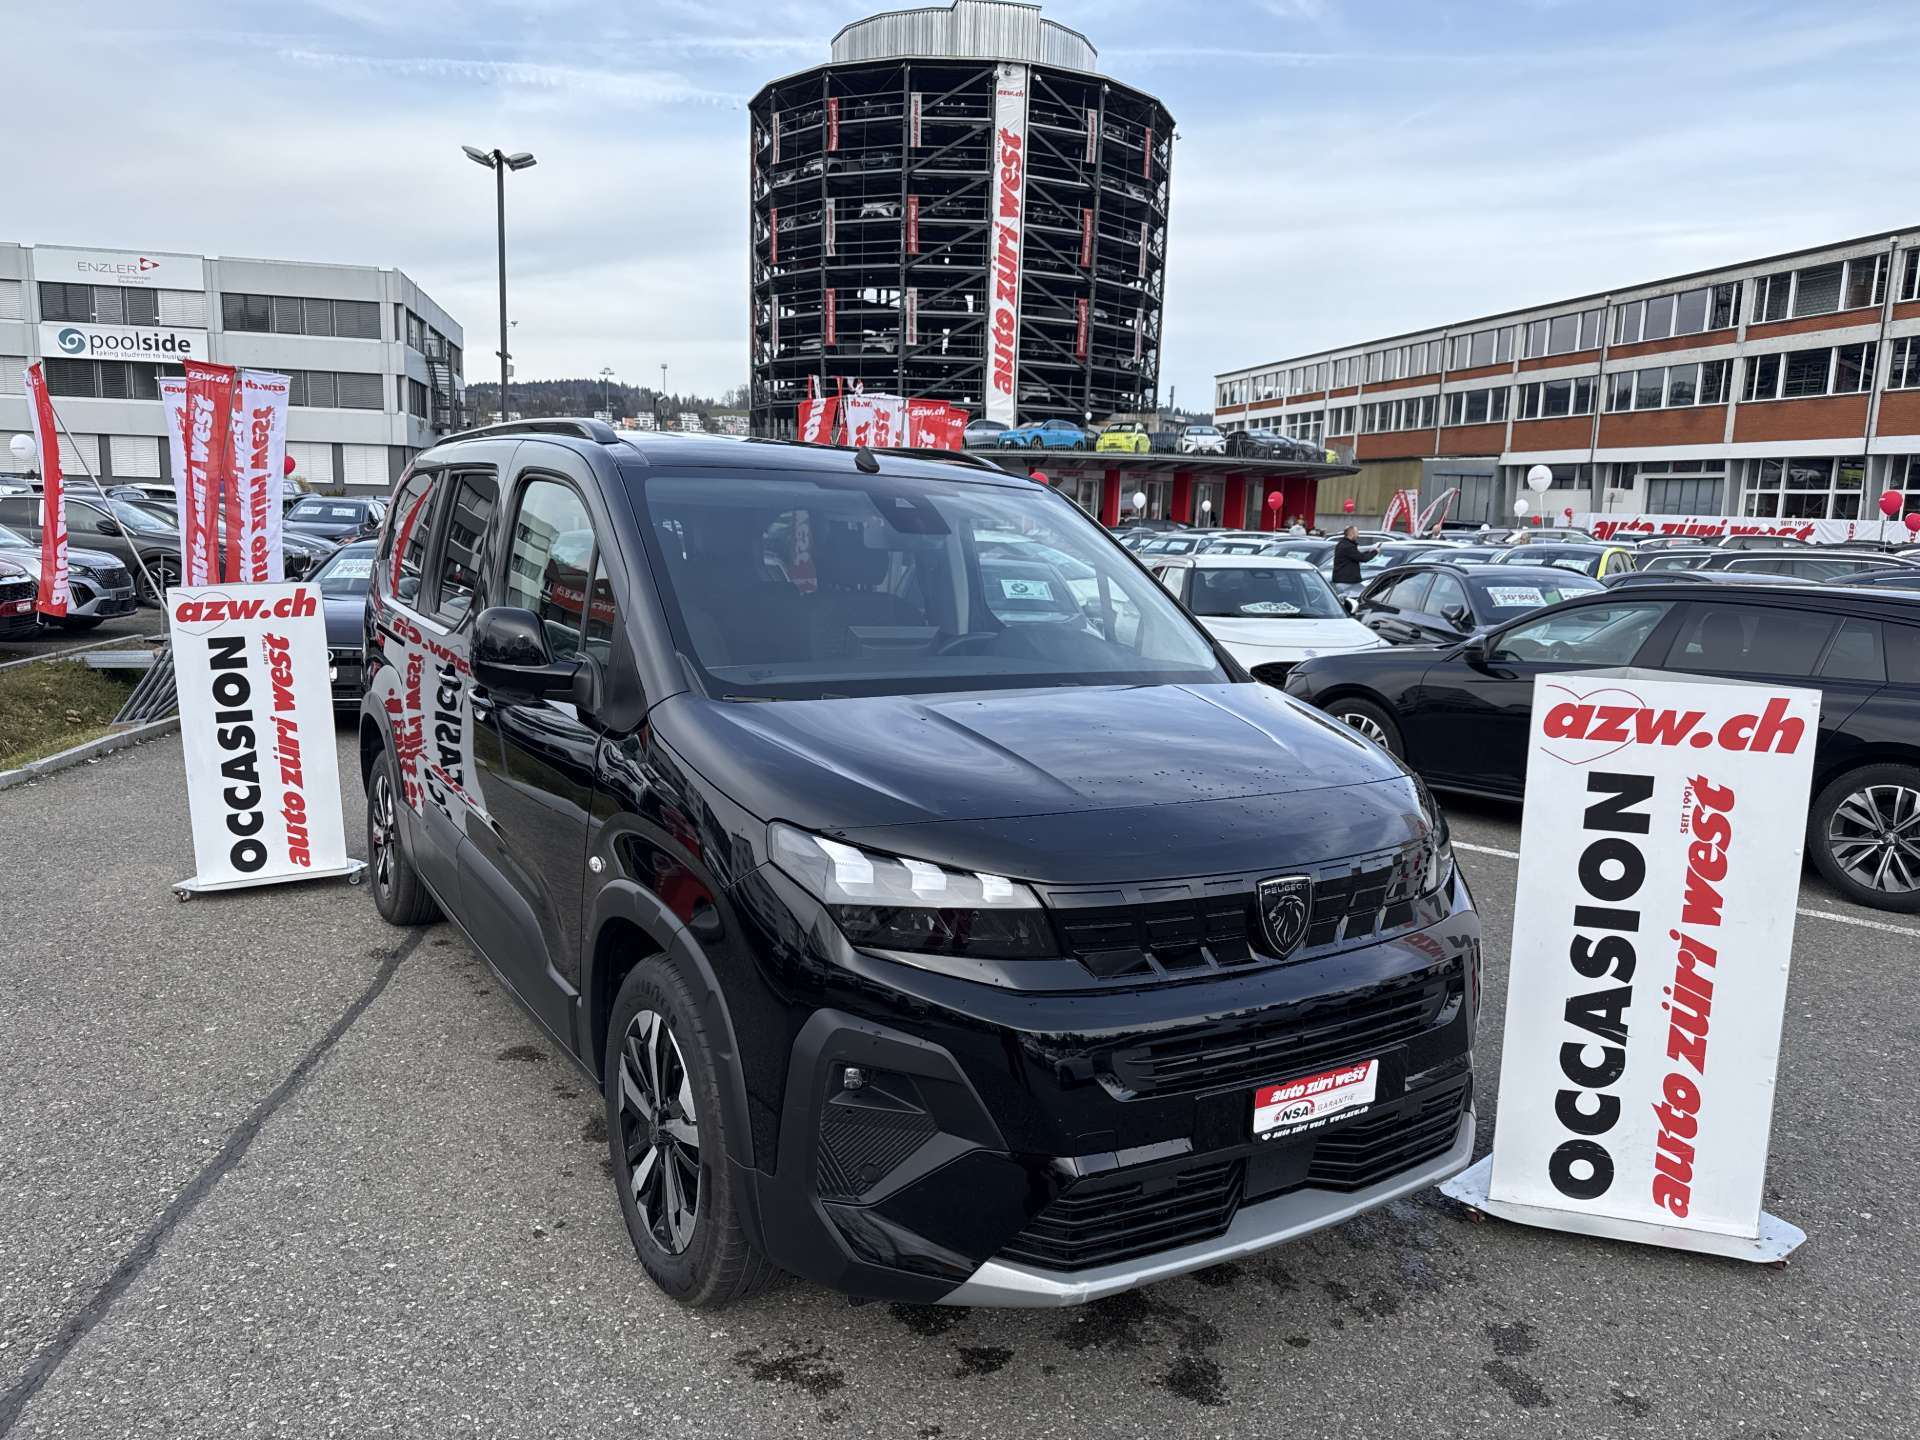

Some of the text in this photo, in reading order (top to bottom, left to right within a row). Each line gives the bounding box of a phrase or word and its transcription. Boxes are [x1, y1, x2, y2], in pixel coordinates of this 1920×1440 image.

[77, 261, 137, 274] ENZLER
[992, 127, 1022, 396] auto züri west
[89, 331, 191, 355] poolside
[120, 351, 151, 359] students
[188, 370, 230, 384] azw.ch
[191, 394, 215, 462] west
[911, 407, 946, 417] azw.ch
[176, 588, 317, 623] azw.ch
[1543, 698, 1806, 754] azw.ch
[207, 636, 268, 873] OCCASION
[264, 632, 311, 869] auto züri west
[1680, 786, 1693, 834] SEIT 1991
[1548, 771, 1655, 1200] OCCASION
[1651, 774, 1735, 1219] auto züri west
[1271, 1067, 1367, 1102] auto züri west
[1280, 1093, 1354, 1121] NSA GARANTIE
[1272, 1129, 1291, 1139] auto
